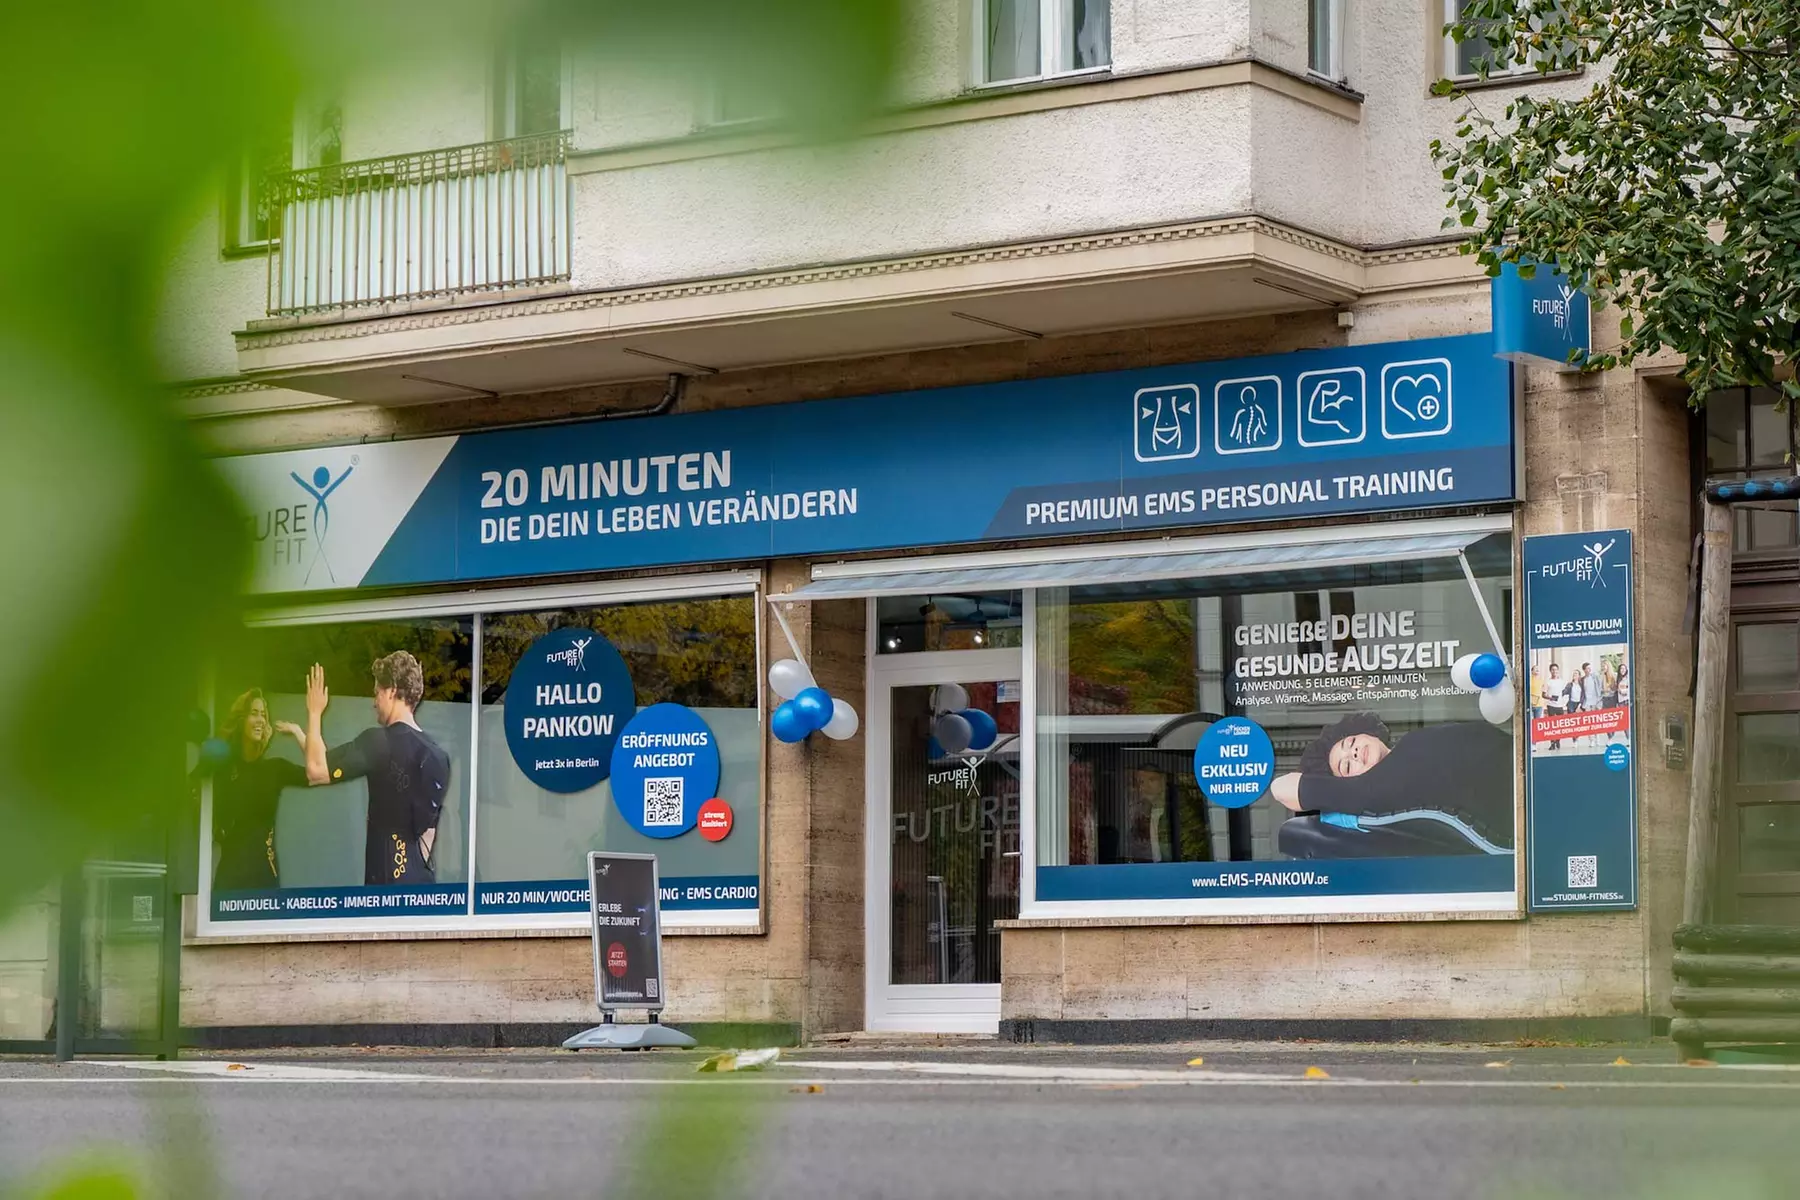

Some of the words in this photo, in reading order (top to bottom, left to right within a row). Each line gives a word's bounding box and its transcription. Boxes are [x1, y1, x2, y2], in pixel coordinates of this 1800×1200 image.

[1532, 299, 1564, 315] FUTURE
[1554, 314, 1564, 329] FIT
[480, 467, 528, 508] 20
[540, 449, 732, 503] MINUTEN
[1025, 494, 1138, 525] PREMIUM
[1144, 489, 1195, 516] EMS
[1201, 478, 1328, 511] PERSONAL
[1333, 467, 1454, 499] TRAINING
[480, 515, 521, 544] DIE
[528, 510, 588, 540] DEIN
[597, 501, 681, 535] LEBEN
[688, 487, 858, 527] VERÄNDERN
[274, 537, 307, 566] FIT
[1542, 556, 1592, 578] FUTURE
[1576, 568, 1592, 582] FIT
[1331, 610, 1415, 641] DEINE
[1534, 621, 1574, 634] DUALES
[1575, 618, 1622, 631] STUDIUM
[546, 649, 578, 663] FUTURE
[567, 657, 577, 667] FIT
[1235, 651, 1338, 678] GESUNDE
[1342, 640, 1460, 673] AUSZEIT
[1235, 682, 1239, 692] 1
[1241, 679, 1303, 692] ANWENDUNG.
[1305, 678, 1312, 689] 5
[1314, 675, 1366, 689] ELEMENTE.
[1368, 674, 1380, 686] 20
[1382, 672, 1428, 685] MINUTEN.
[535, 682, 602, 706] HALLO
[523, 714, 614, 739] PANKOW
[1536, 721, 1550, 731] DU
[1551, 717, 1582, 729] LIEBST
[1583, 711, 1624, 725] FITNESS?
[621, 731, 708, 749] ERÖFFNUNGS
[1219, 744, 1249, 758] NEU
[535, 759, 554, 771] jetzt
[555, 759, 566, 768] 3x
[566, 758, 574, 768] in
[575, 757, 599, 768] Berlin
[633, 752, 696, 768] ANGEBOT
[928, 768, 969, 785] FUTURE
[1201, 762, 1268, 778] EXKLUSIV
[955, 779, 969, 790] FIT
[1209, 783, 1232, 794] NUR
[1234, 782, 1259, 793] HIER
[892, 793, 1020, 844] FUTURE
[1191, 871, 1329, 888] www.EMS-PANKOW.DE
[219, 898, 280, 912] INDIVIDUELL
[286, 896, 338, 910] KABELLOS
[343, 894, 380, 908] IMMER
[381, 894, 403, 907] MIT
[403, 892, 465, 906] TRAINER/IN
[481, 892, 505, 905] NUR
[506, 891, 521, 904] 20
[522, 889, 591, 904] MIN/WOCHE
[686, 886, 712, 899] EMS
[714, 885, 757, 899] CARDIO
[598, 902, 622, 913] ERLEBE
[599, 915, 610, 926] DIE
[610, 916, 641, 927] ZUKUNFT
